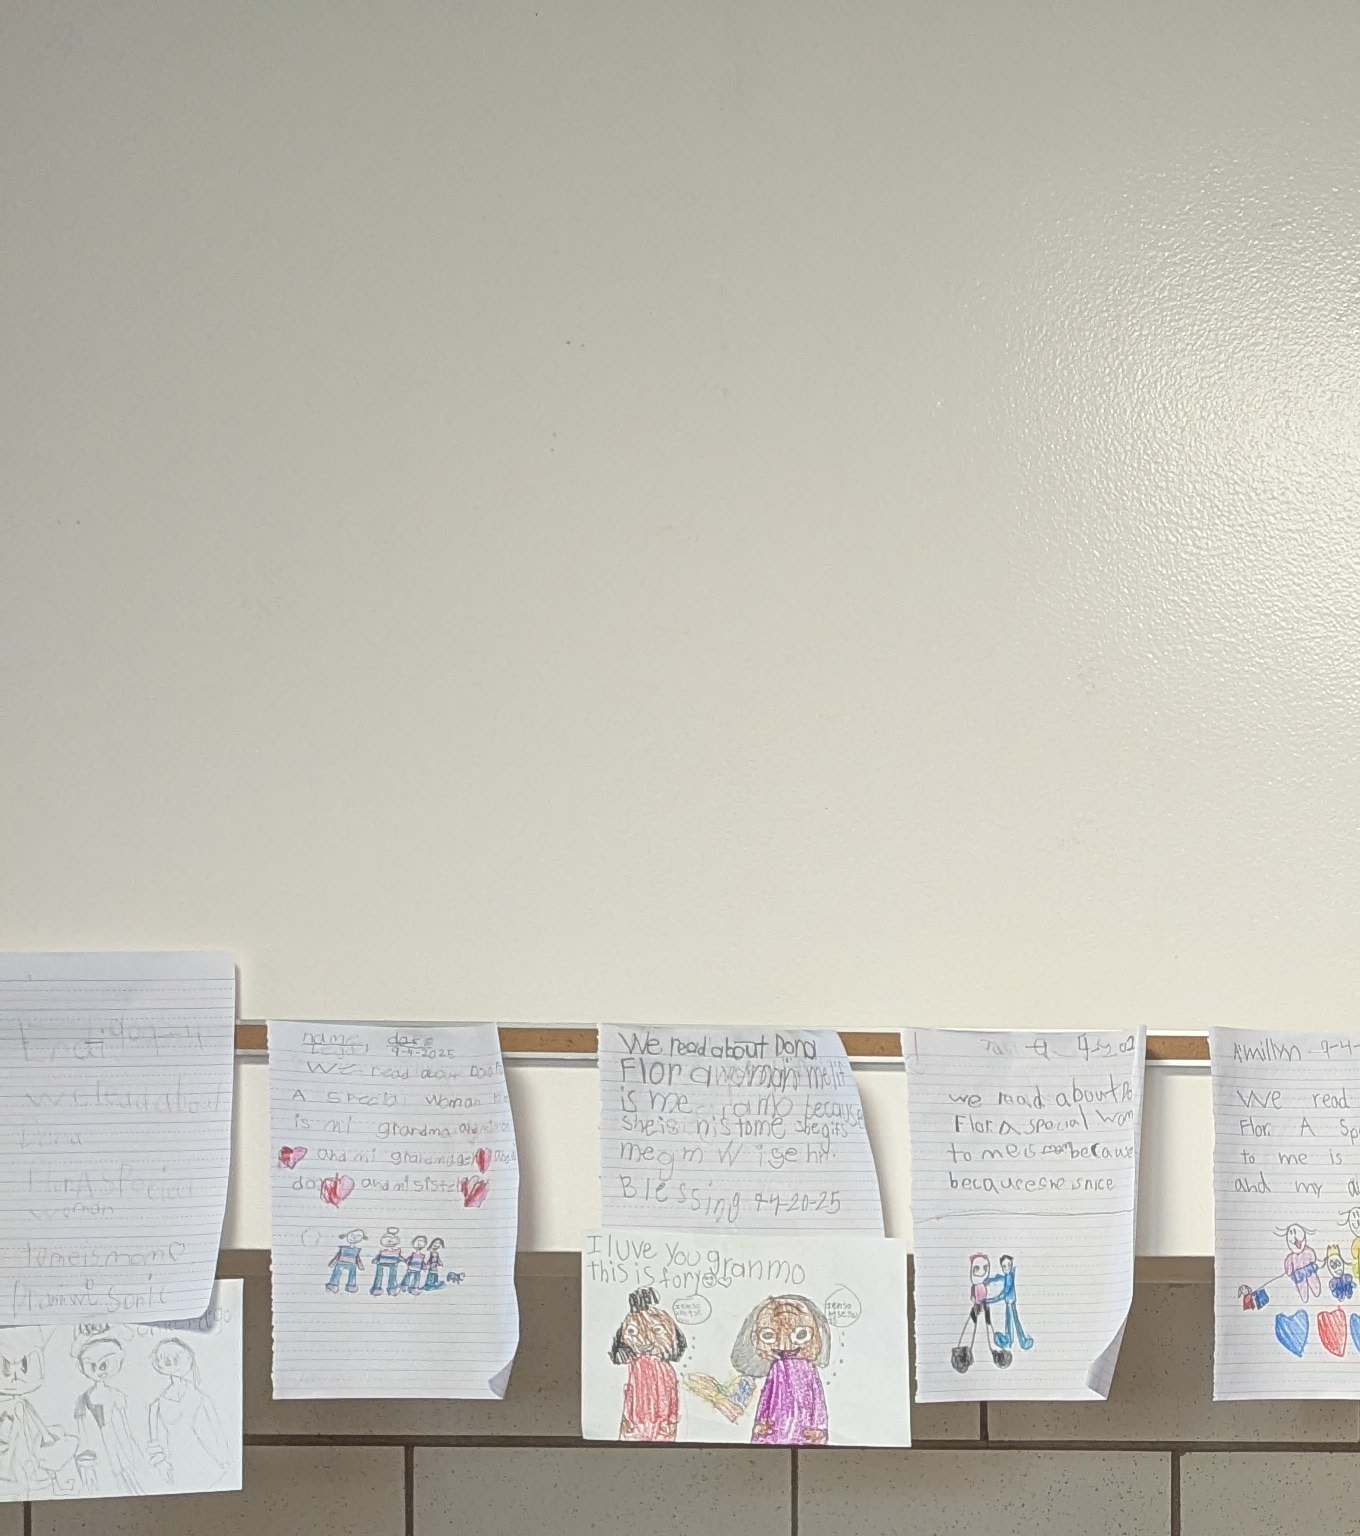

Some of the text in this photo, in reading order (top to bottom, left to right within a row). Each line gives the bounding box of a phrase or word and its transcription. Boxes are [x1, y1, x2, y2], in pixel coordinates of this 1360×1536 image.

[618, 1032, 662, 1056] We
[710, 1035, 768, 1059] about
[620, 1058, 681, 1084] Flor
[1237, 1088, 1350, 1109] We read
[1301, 1117, 1316, 1137] A
[1241, 1149, 1342, 1165] to me is
[620, 1174, 740, 1223] Blessing
